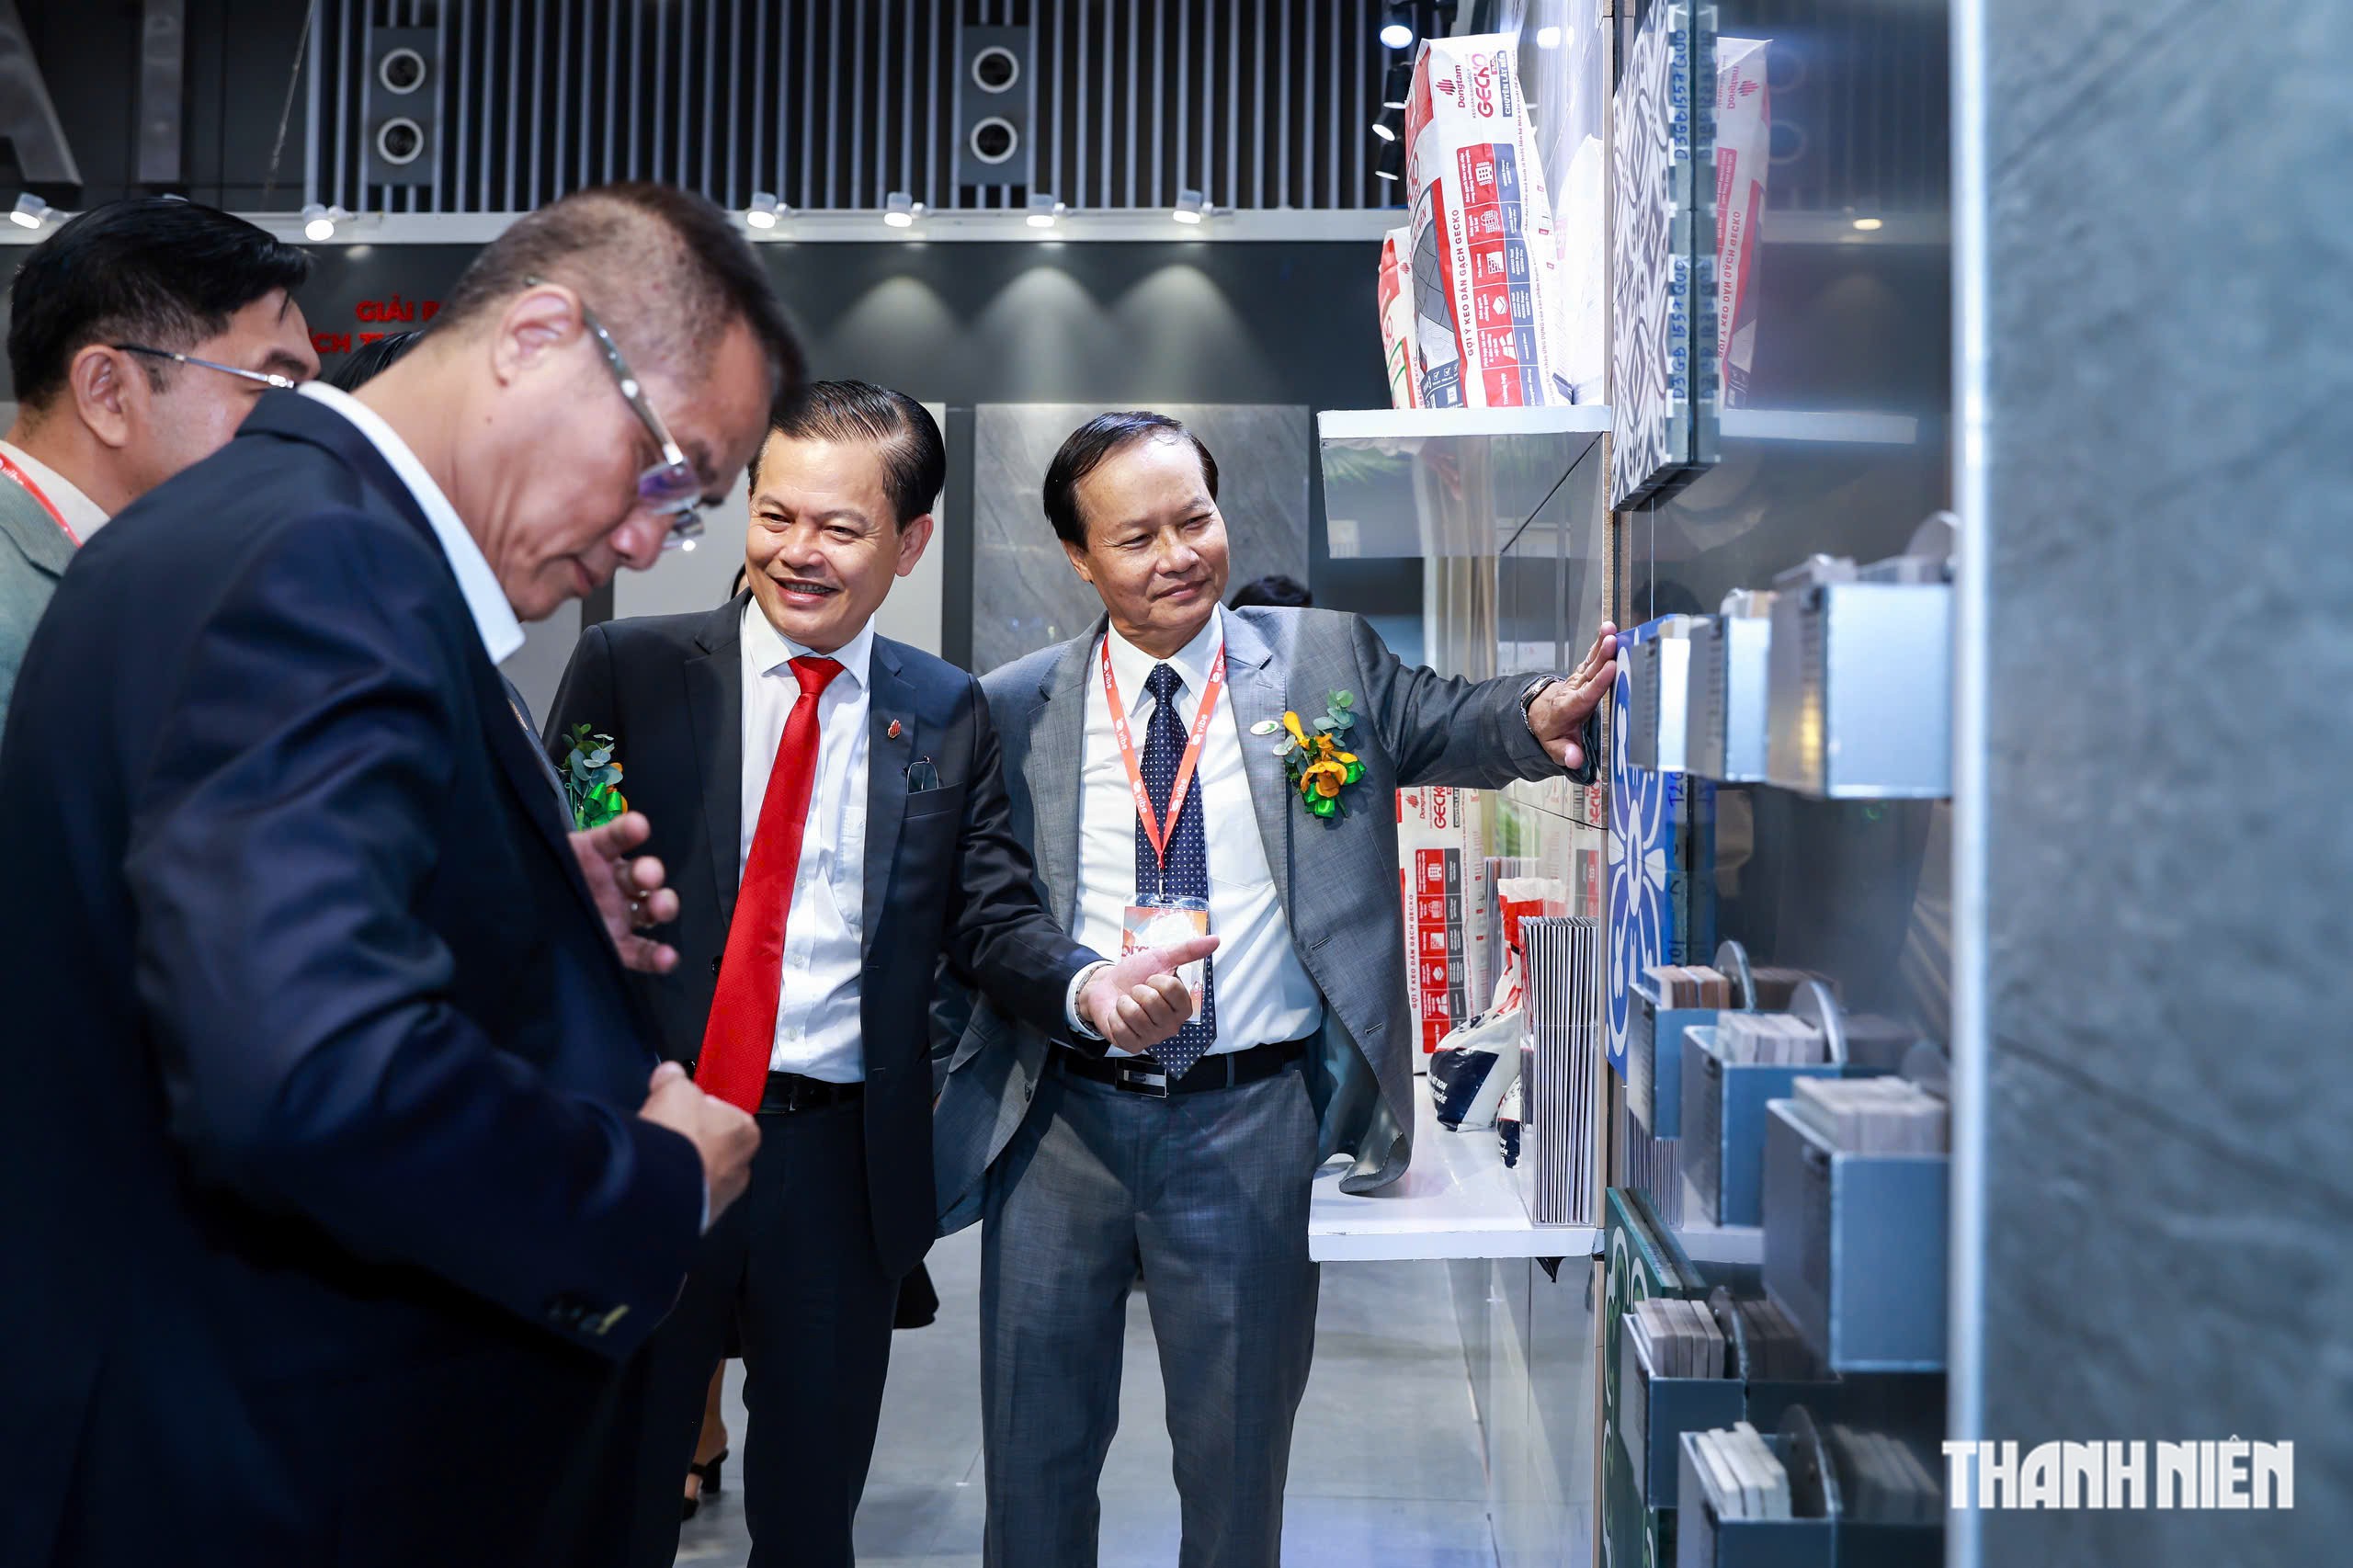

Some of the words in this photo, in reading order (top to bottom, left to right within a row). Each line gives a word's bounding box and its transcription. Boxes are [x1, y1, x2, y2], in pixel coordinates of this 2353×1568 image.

[1455, 65, 1465, 108] Dongtam
[1472, 53, 1494, 119] GECKO
[1500, 69, 1508, 83] LÁT
[1502, 84, 1512, 114] CHUYÊN
[1451, 210, 1461, 244] GECKO
[1456, 247, 1469, 277] GẠCH
[1459, 279, 1468, 301] DÁN
[355, 293, 415, 322] GIẢI
[1462, 304, 1471, 325] KEO
[1465, 337, 1475, 357] GỢI
[1216, 654, 1225, 672] vibe
[1105, 670, 1113, 690] vibe
[1197, 714, 1209, 733] vibe
[1118, 731, 1128, 751] vibe
[1176, 778, 1188, 799] vibe
[1136, 793, 1148, 814] vibe
